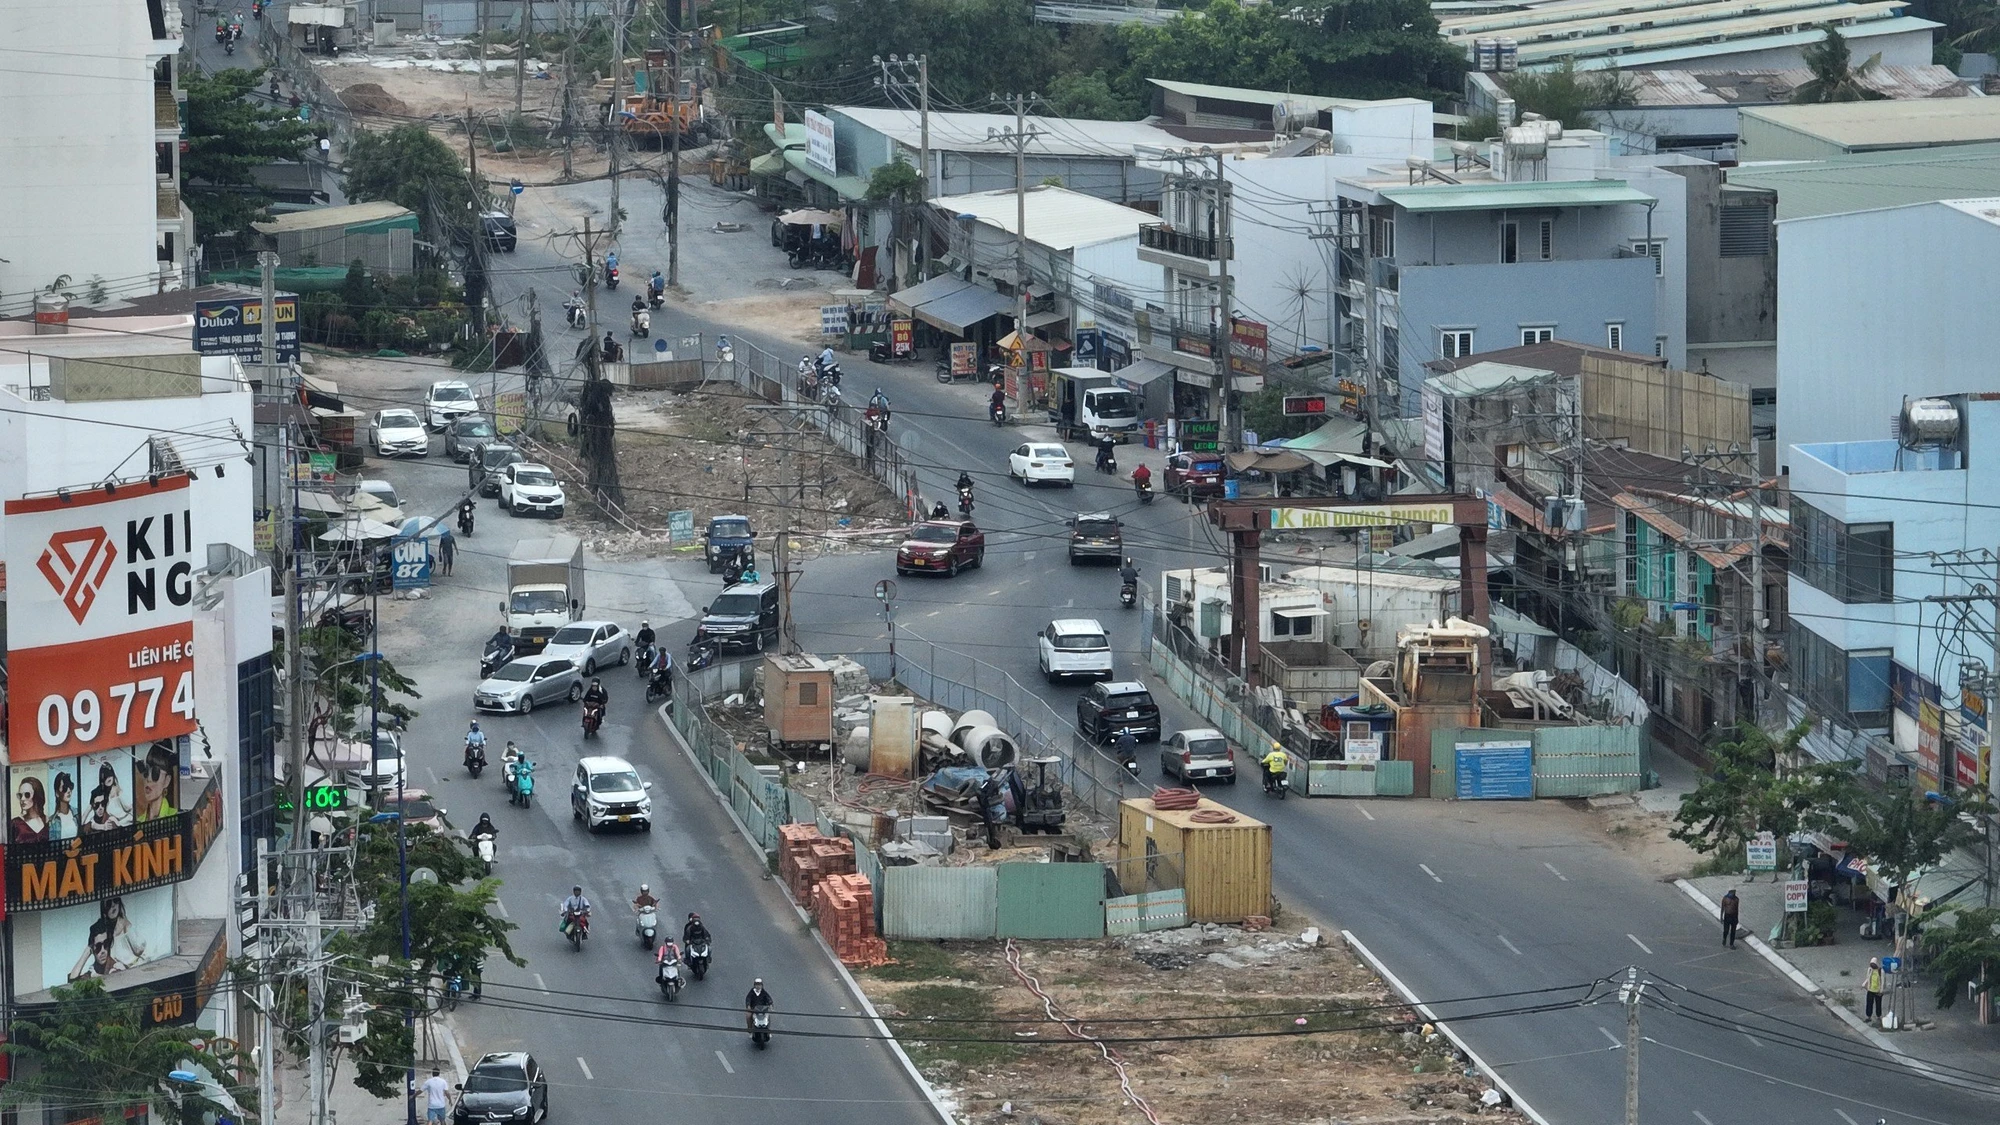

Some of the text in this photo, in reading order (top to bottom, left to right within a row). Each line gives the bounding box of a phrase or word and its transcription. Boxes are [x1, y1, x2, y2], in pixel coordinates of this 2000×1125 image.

[257, 305, 293, 321] JUN
[200, 316, 234, 328] Dulux
[894, 321, 911, 331] BÚN
[897, 331, 909, 341] BÒ
[895, 342, 910, 352] 25K
[396, 563, 426, 578] 87
[129, 646, 160, 669] LIÊN
[162, 639, 181, 663] HỆ
[22, 830, 183, 902] MẮT KÍNH
[1786, 883, 1807, 891] PHOTO
[1786, 892, 1806, 901] COPY
